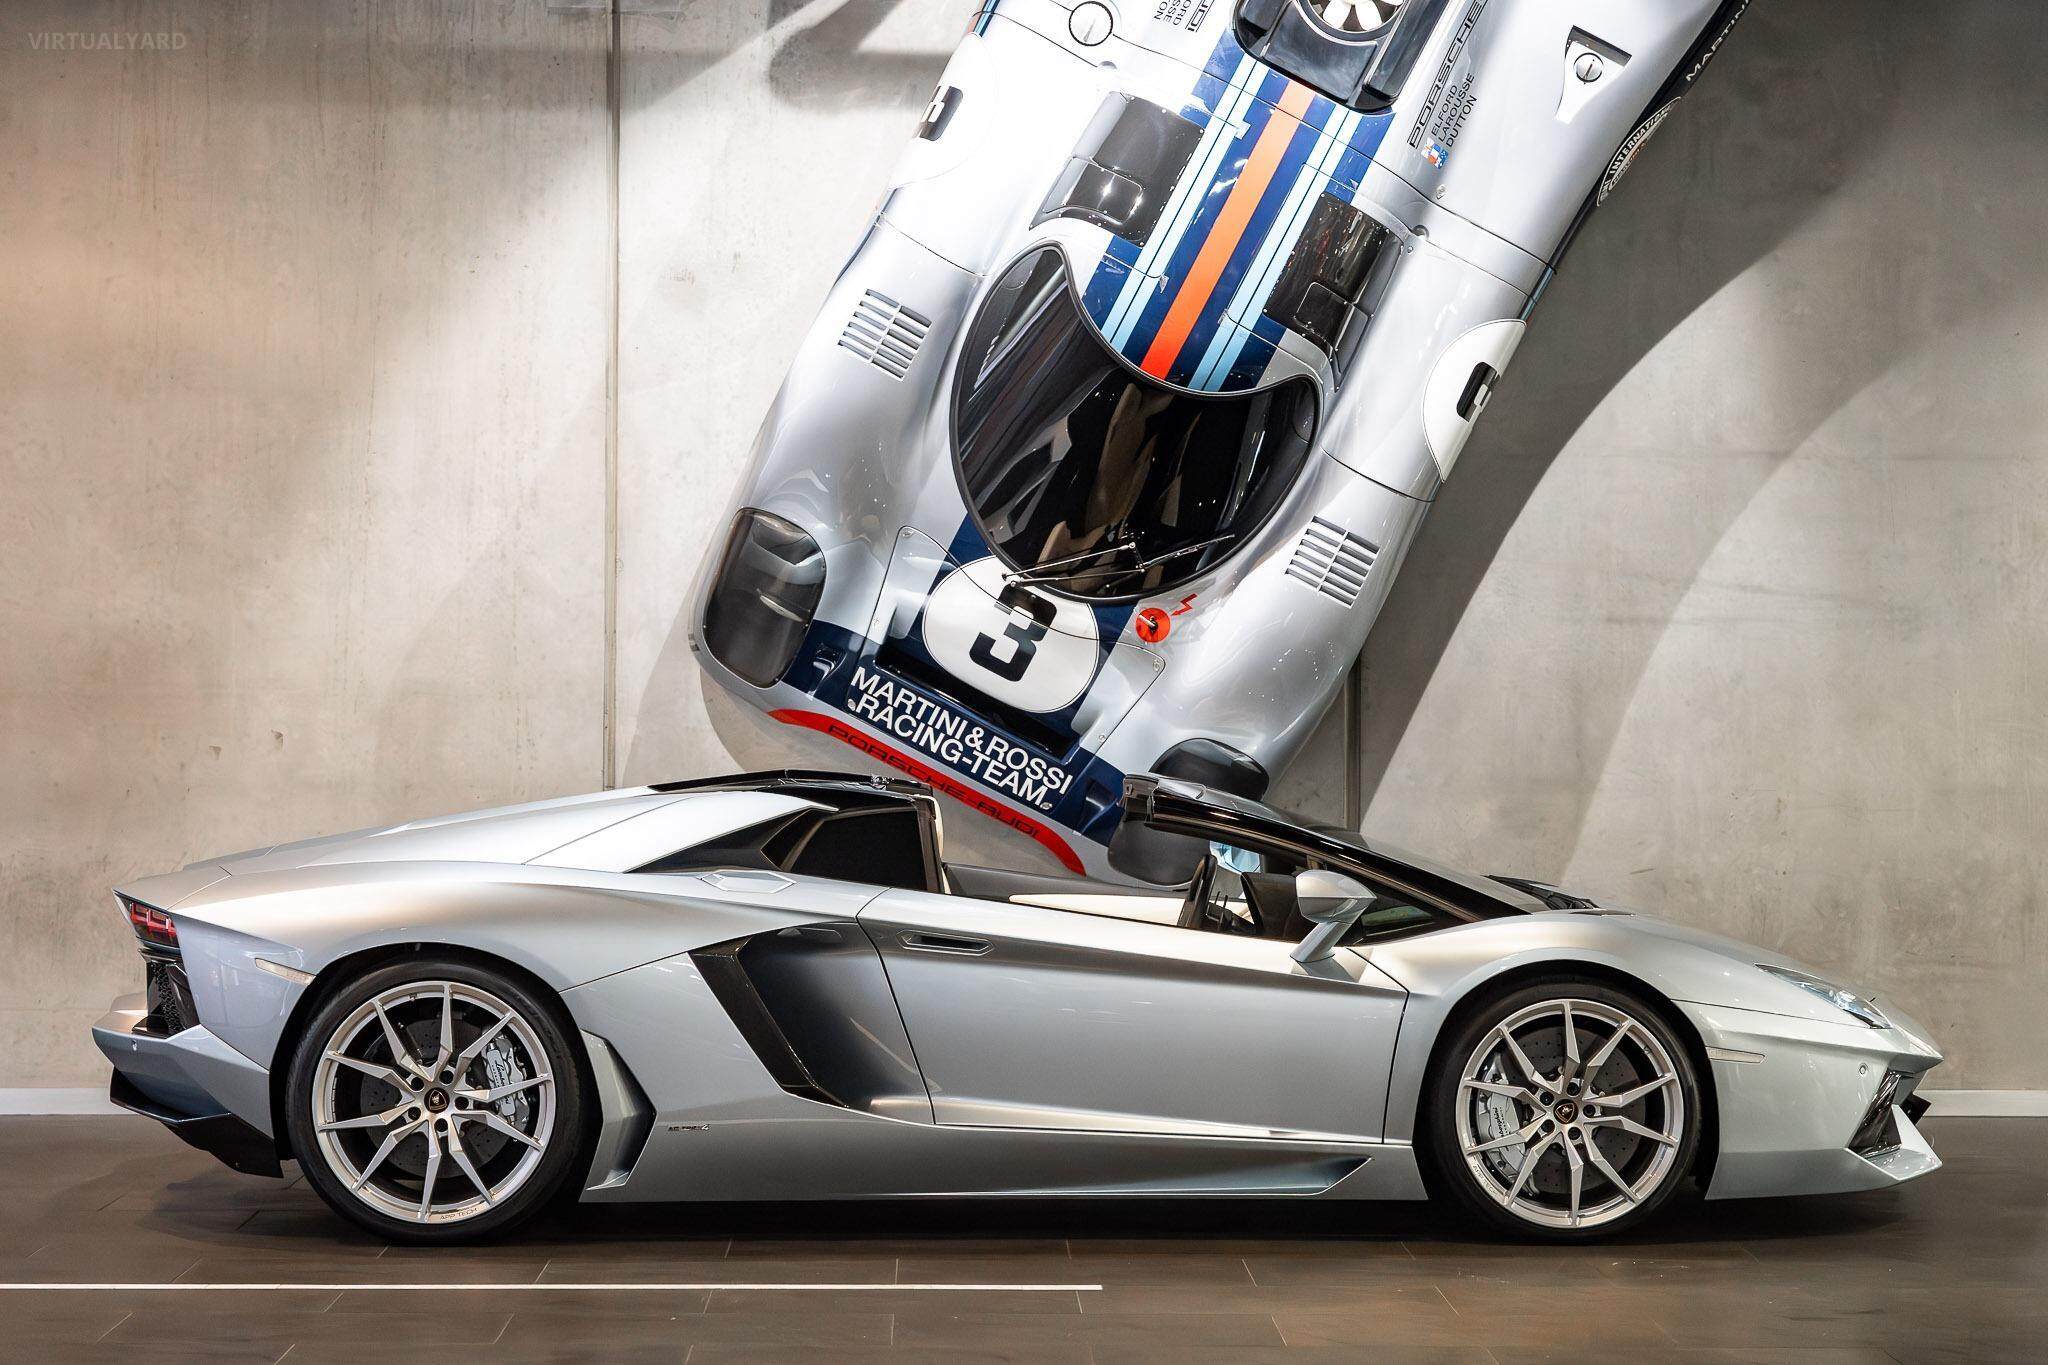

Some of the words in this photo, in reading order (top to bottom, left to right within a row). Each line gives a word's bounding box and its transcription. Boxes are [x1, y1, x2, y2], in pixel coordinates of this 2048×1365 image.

[1431, 84, 1458, 137] ELFORD
[1438, 72, 1475, 142] LAROUSSE
[1445, 94, 1478, 147] DUTTON
[968, 582, 1057, 682] 3
[855, 693, 1053, 806] RACING-TEAM
